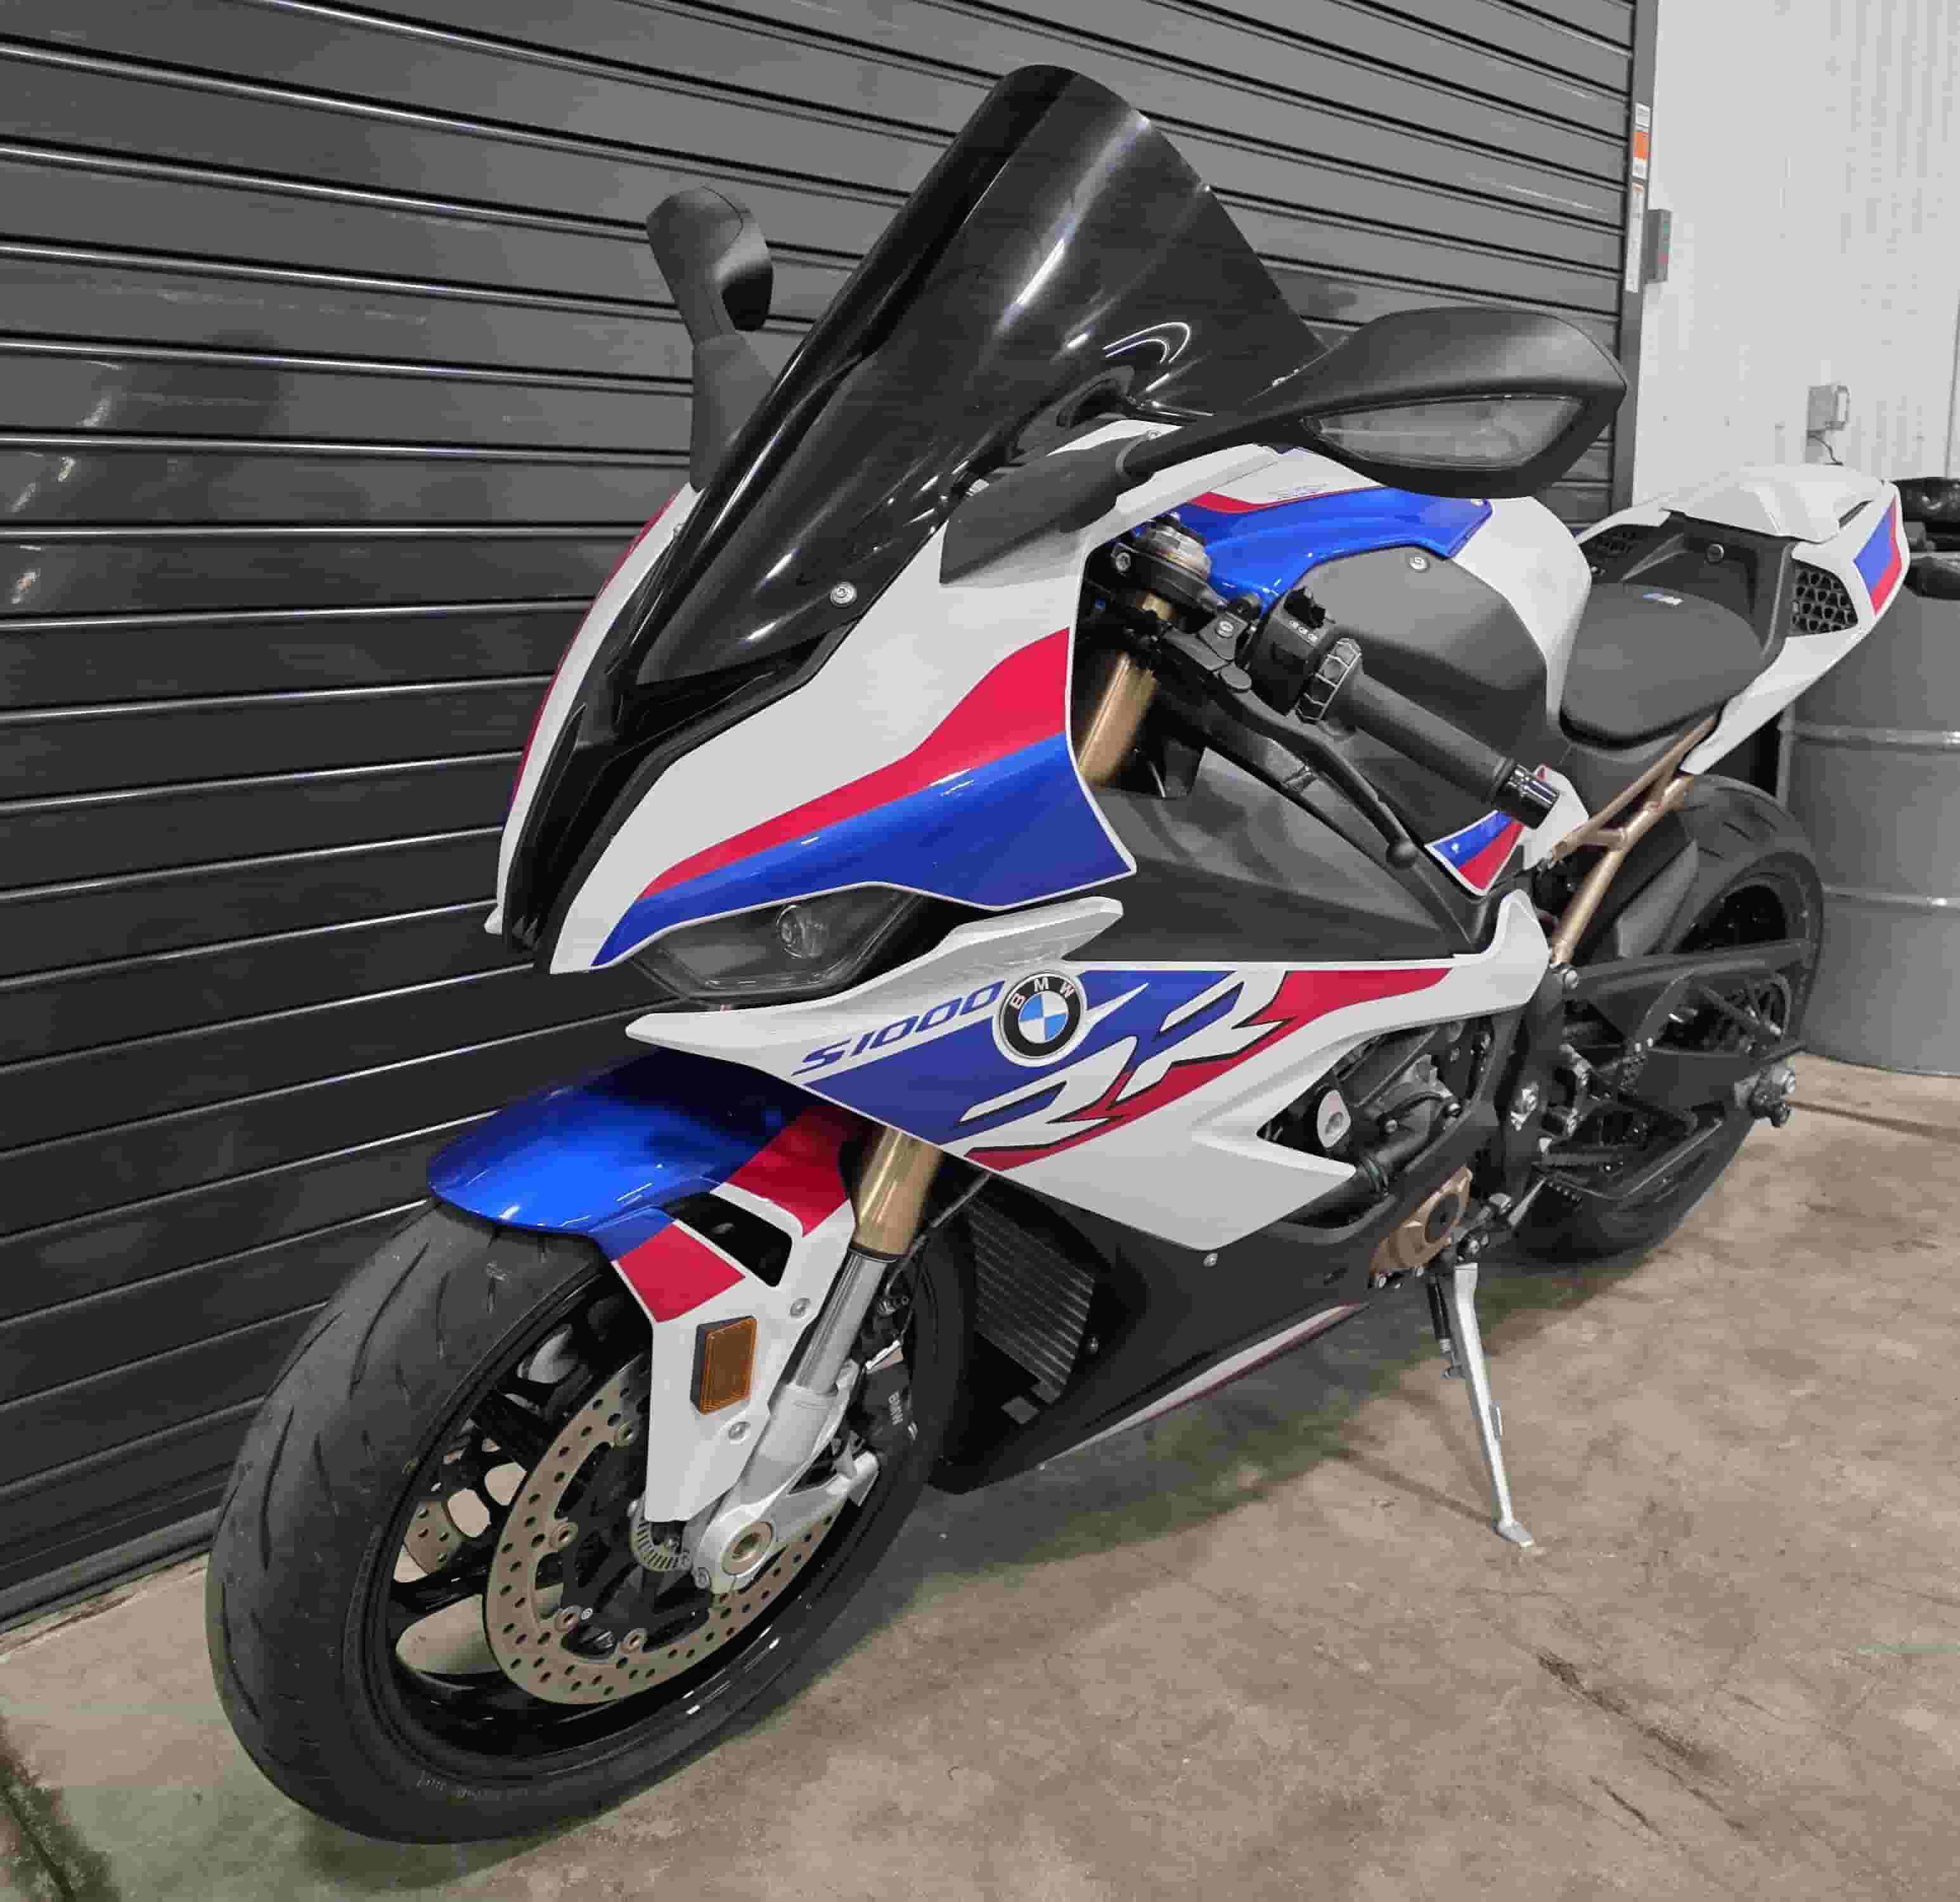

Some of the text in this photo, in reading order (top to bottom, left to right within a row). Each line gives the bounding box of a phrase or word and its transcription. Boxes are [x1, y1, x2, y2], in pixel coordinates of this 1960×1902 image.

[1009, 977, 1076, 1009] BMW
[791, 971, 1294, 1153] S1000 RR
